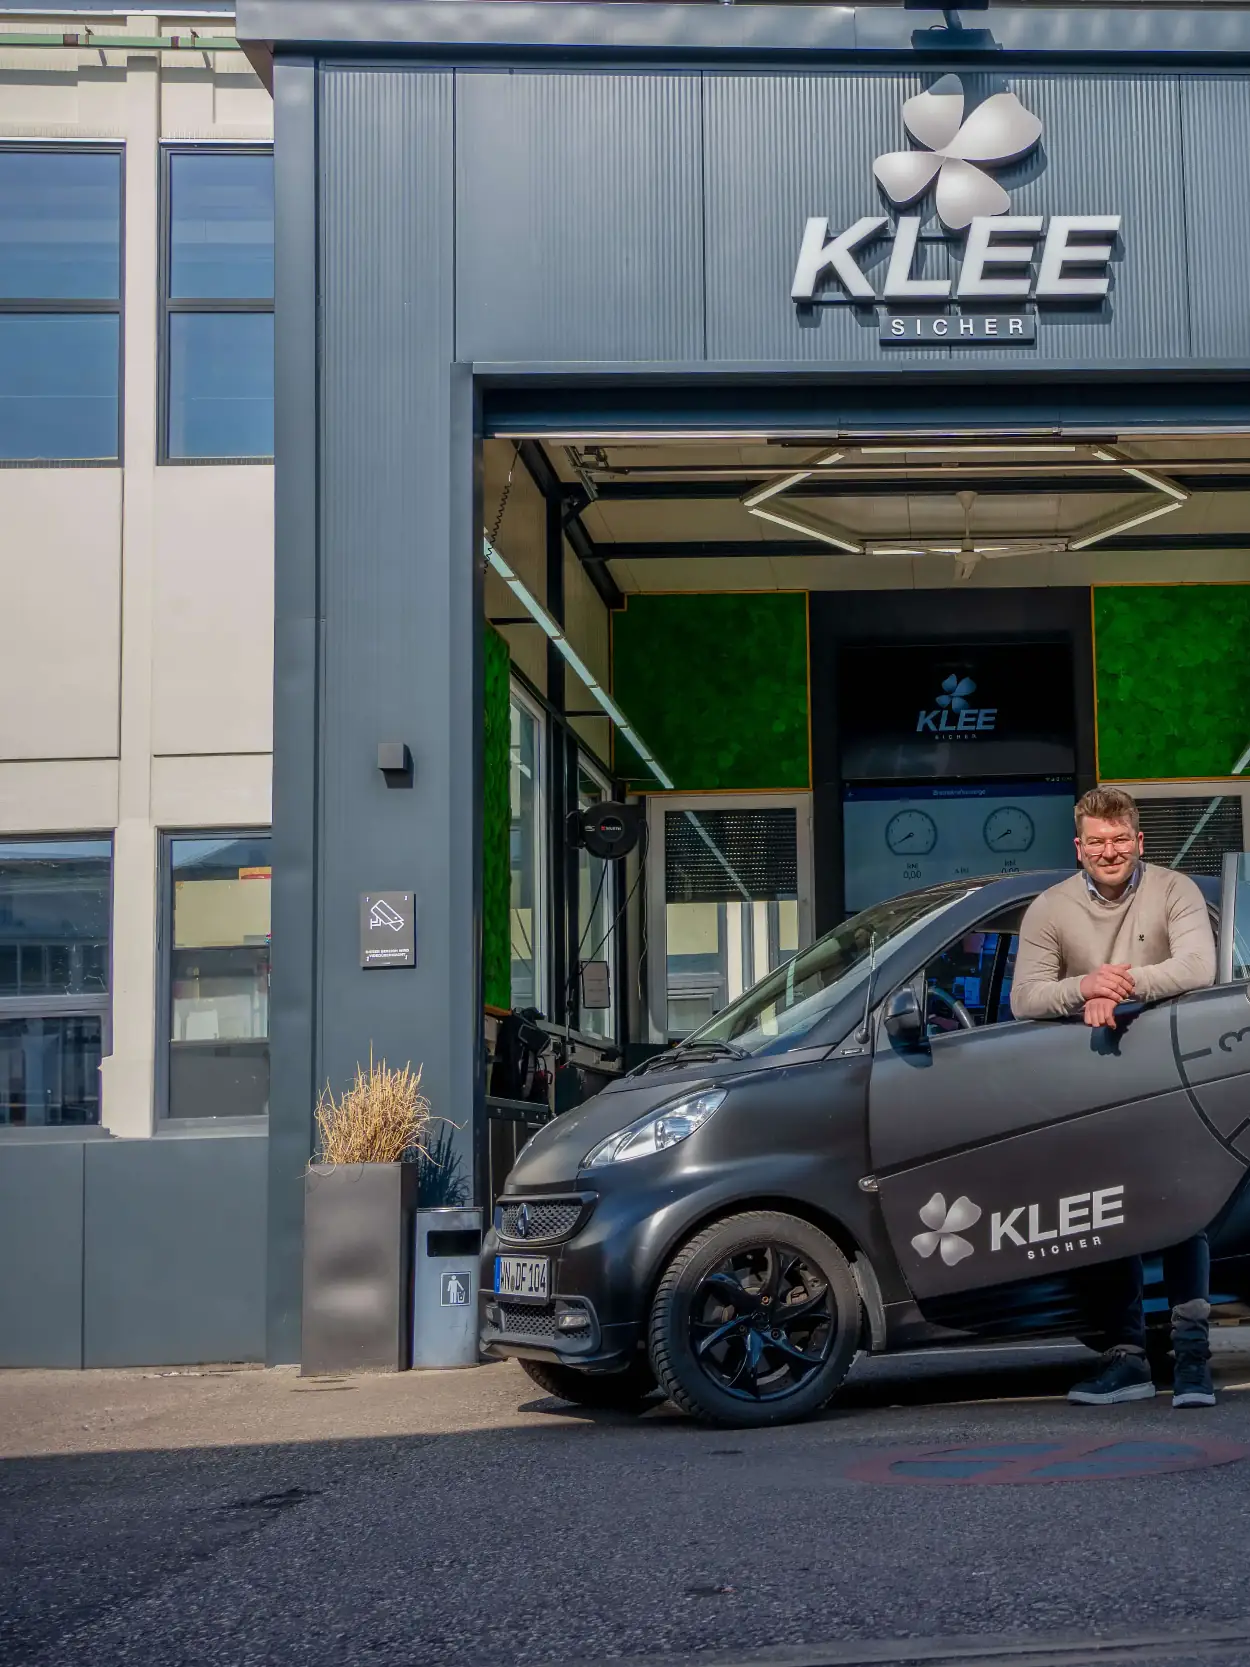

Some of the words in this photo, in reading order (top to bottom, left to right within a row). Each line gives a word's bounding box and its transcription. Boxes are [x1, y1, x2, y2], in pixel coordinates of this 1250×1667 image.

[790, 214, 1122, 300] KLEE
[890, 317, 1025, 336] SICHER
[916, 708, 998, 732] KLEE
[991, 1185, 1124, 1251] KLEE
[1027, 1236, 1102, 1260] SICHER
[515, 1262, 528, 1291] DF
[529, 1264, 546, 1292] 104
